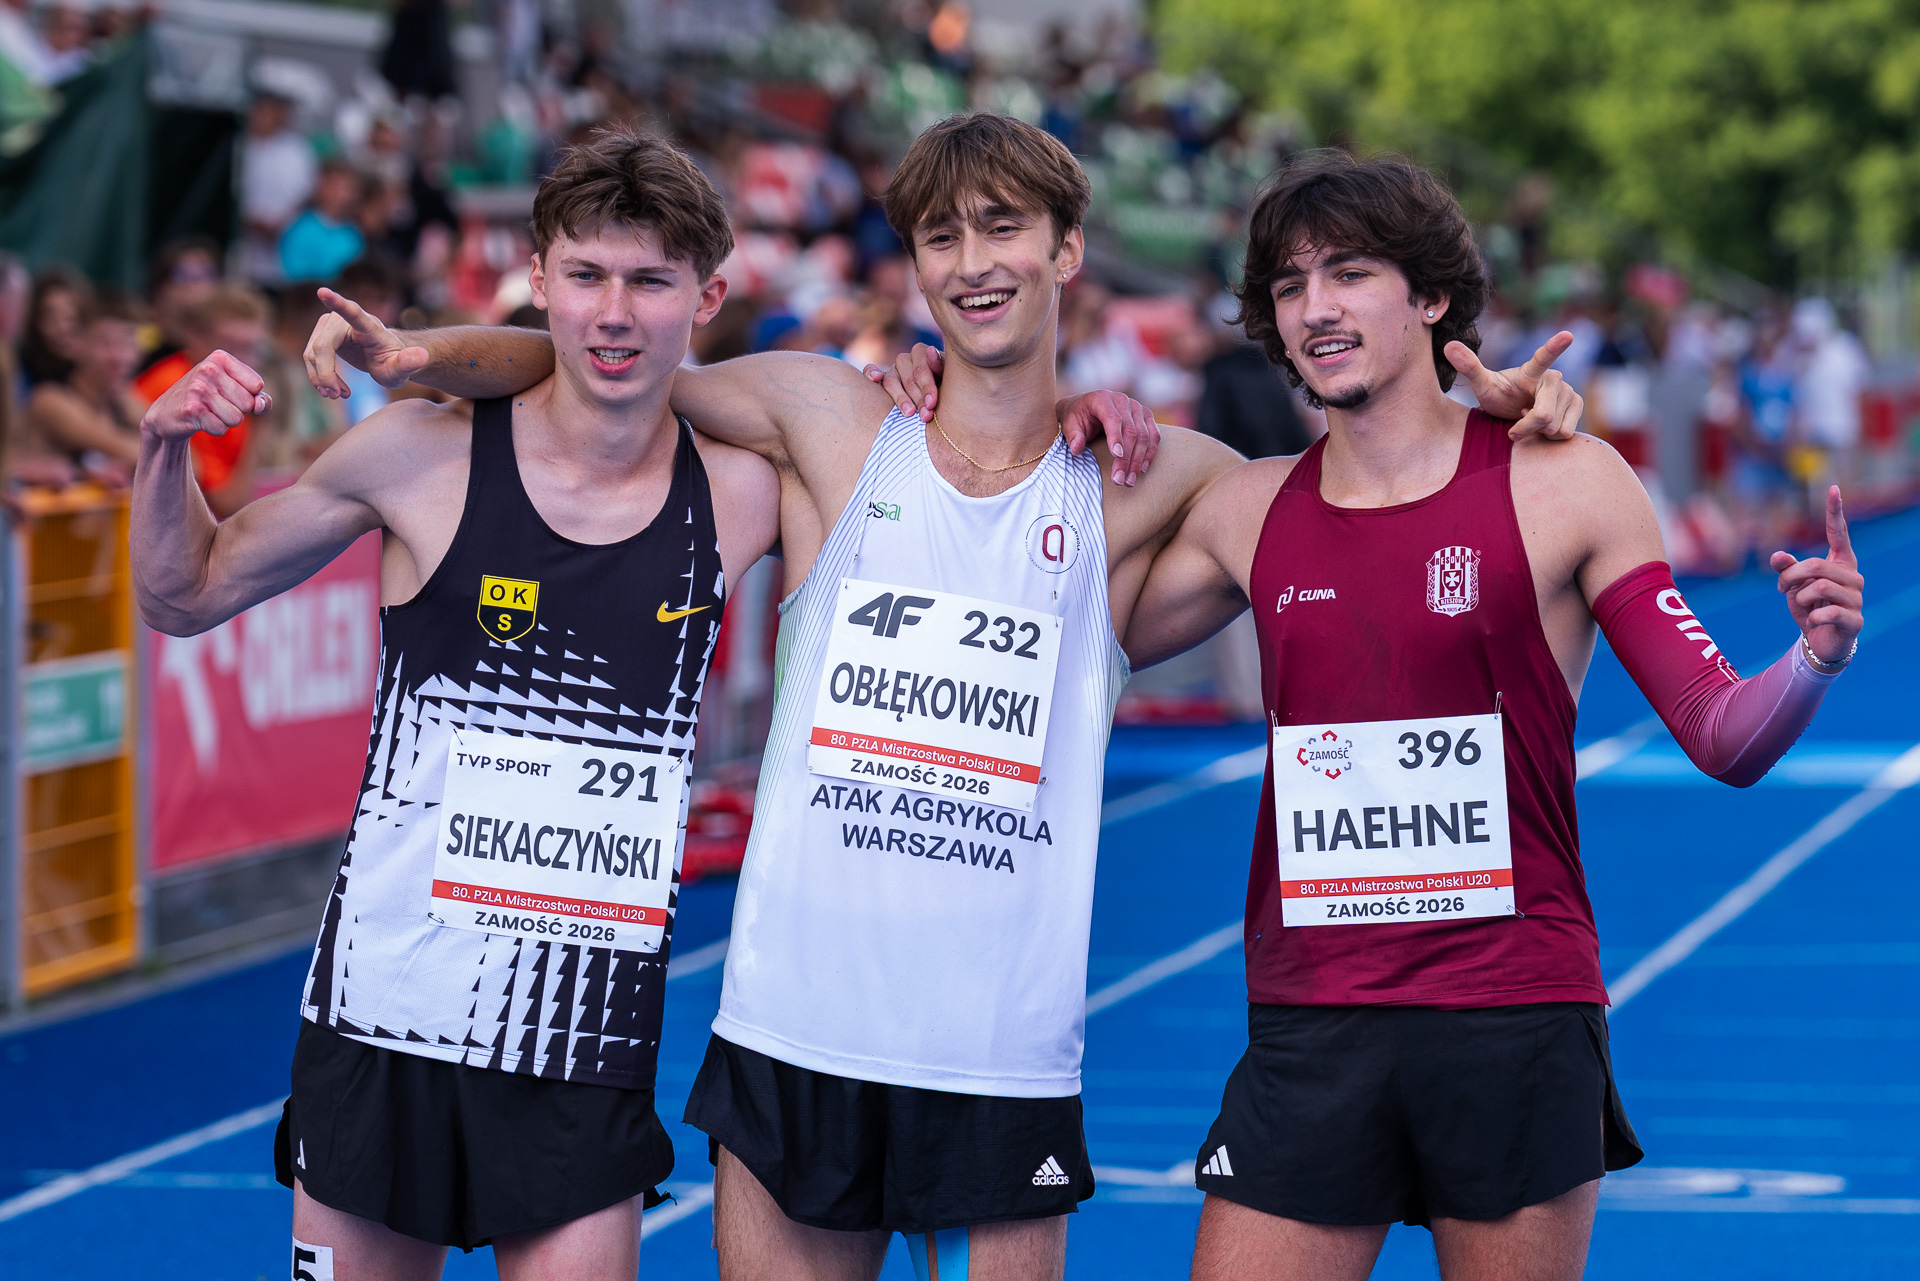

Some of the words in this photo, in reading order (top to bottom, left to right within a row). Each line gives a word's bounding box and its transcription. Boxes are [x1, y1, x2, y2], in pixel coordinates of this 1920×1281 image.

[1436, 555, 1471, 566] RESOVIA
[1298, 588, 1337, 602] CUNA
[848, 592, 935, 639] 4F
[959, 610, 1041, 660] 232
[830, 662, 1039, 738] OBŁĘKOWSKI
[457, 752, 491, 770] TVP
[495, 758, 552, 777] SPORT
[830, 733, 849, 746] 80.
[851, 737, 879, 752] PZLA
[882, 741, 956, 764] Mistrzostwa
[958, 755, 995, 772] Polski
[997, 763, 1021, 777] U20
[1308, 747, 1350, 761] ZAMOŚĆ
[1398, 728, 1482, 770] 396
[578, 758, 659, 803] 291
[850, 759, 937, 785] ZAMOŚĆ
[941, 774, 990, 795] 2026
[810, 783, 883, 814] ATAK
[890, 793, 1053, 846] AGRYKOLA
[1293, 800, 1491, 853] HAEHNE
[446, 813, 661, 880] SIEKACZYŃSKI
[842, 823, 1015, 874] WARSZAWA
[1300, 883, 1319, 895] 80.
[1321, 882, 1349, 894] PZLA
[1351, 878, 1424, 893] Mistrzostwa
[1426, 875, 1464, 889] Polski
[1466, 874, 1492, 886] U20
[452, 886, 471, 900] 80.
[473, 890, 503, 904] PZLA
[505, 893, 581, 914] Mistrzostwa
[584, 904, 619, 919] Polski
[622, 908, 646, 921] U20
[1327, 896, 1411, 918] ZAMOŚĆ
[1415, 897, 1465, 915] 2026
[475, 911, 563, 936] ZAMOŚĆ
[567, 923, 616, 942] 2026
[1032, 1175, 1070, 1186] adidas
